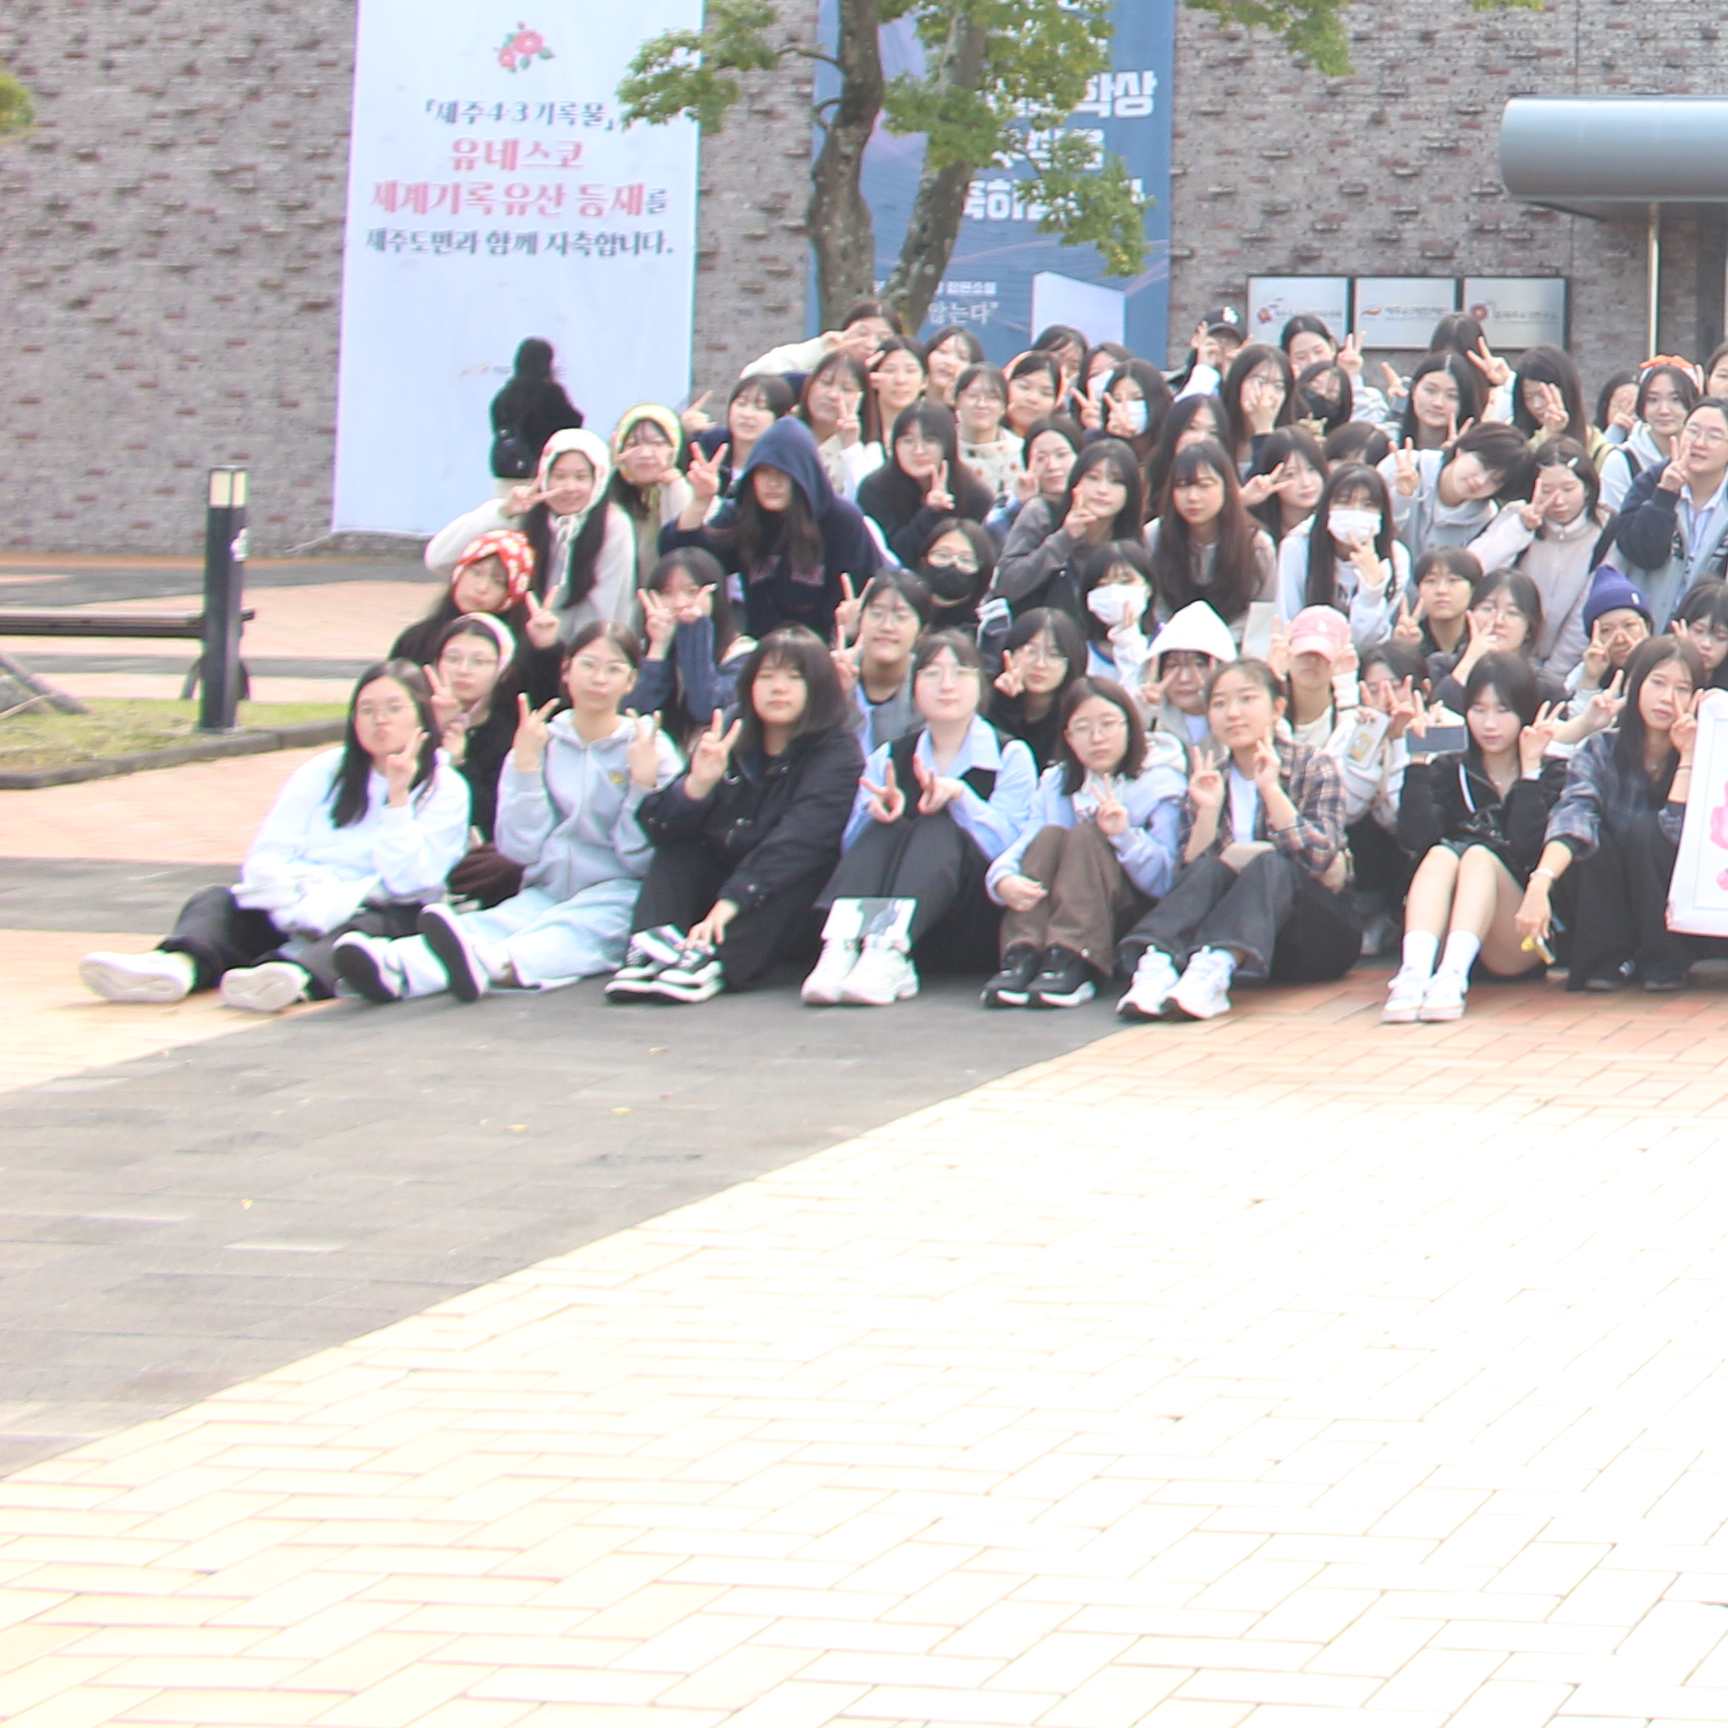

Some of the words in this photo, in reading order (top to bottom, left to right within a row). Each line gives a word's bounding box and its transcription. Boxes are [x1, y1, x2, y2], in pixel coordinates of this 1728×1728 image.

[448, 136, 585, 171] 유네스코
[576, 181, 668, 218] 등재를
[366, 227, 479, 255] 제주도민과
[485, 228, 539, 256] 함께
